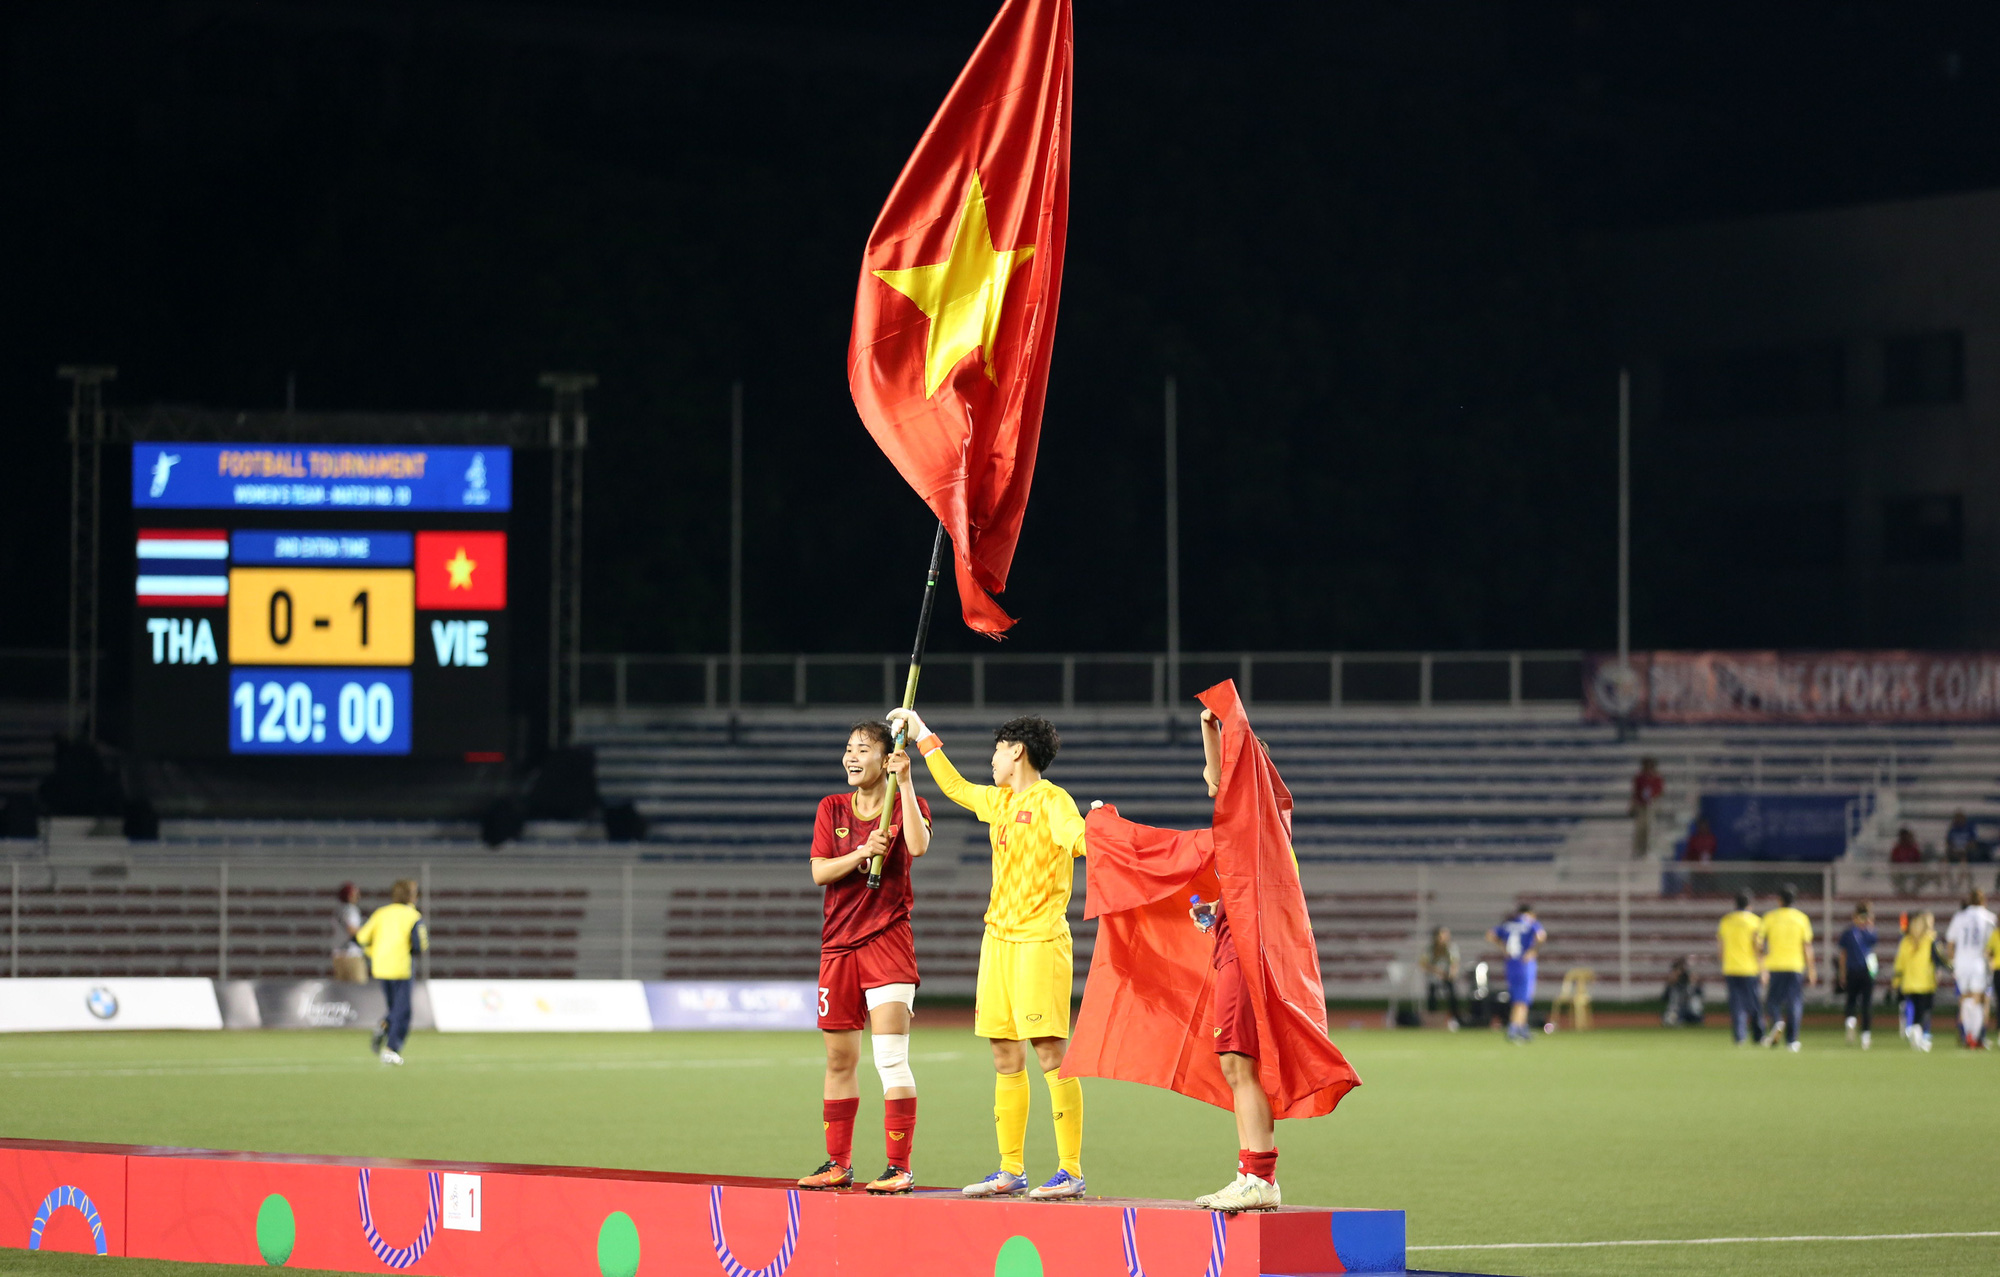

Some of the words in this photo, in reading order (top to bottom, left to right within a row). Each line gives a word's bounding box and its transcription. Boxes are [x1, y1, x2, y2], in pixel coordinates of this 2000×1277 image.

[218, 451, 307, 478] FOOTBALL
[308, 452, 428, 479] TOURNAMENT
[147, 618, 219, 665] THA
[270, 589, 293, 646] 0
[353, 590, 369, 647] 1
[431, 620, 489, 667] VIE
[1812, 662, 1919, 714] SPORTS
[1927, 662, 2000, 714] COM
[818, 987, 830, 1017] 3
[469, 1188, 474, 1218] 1
